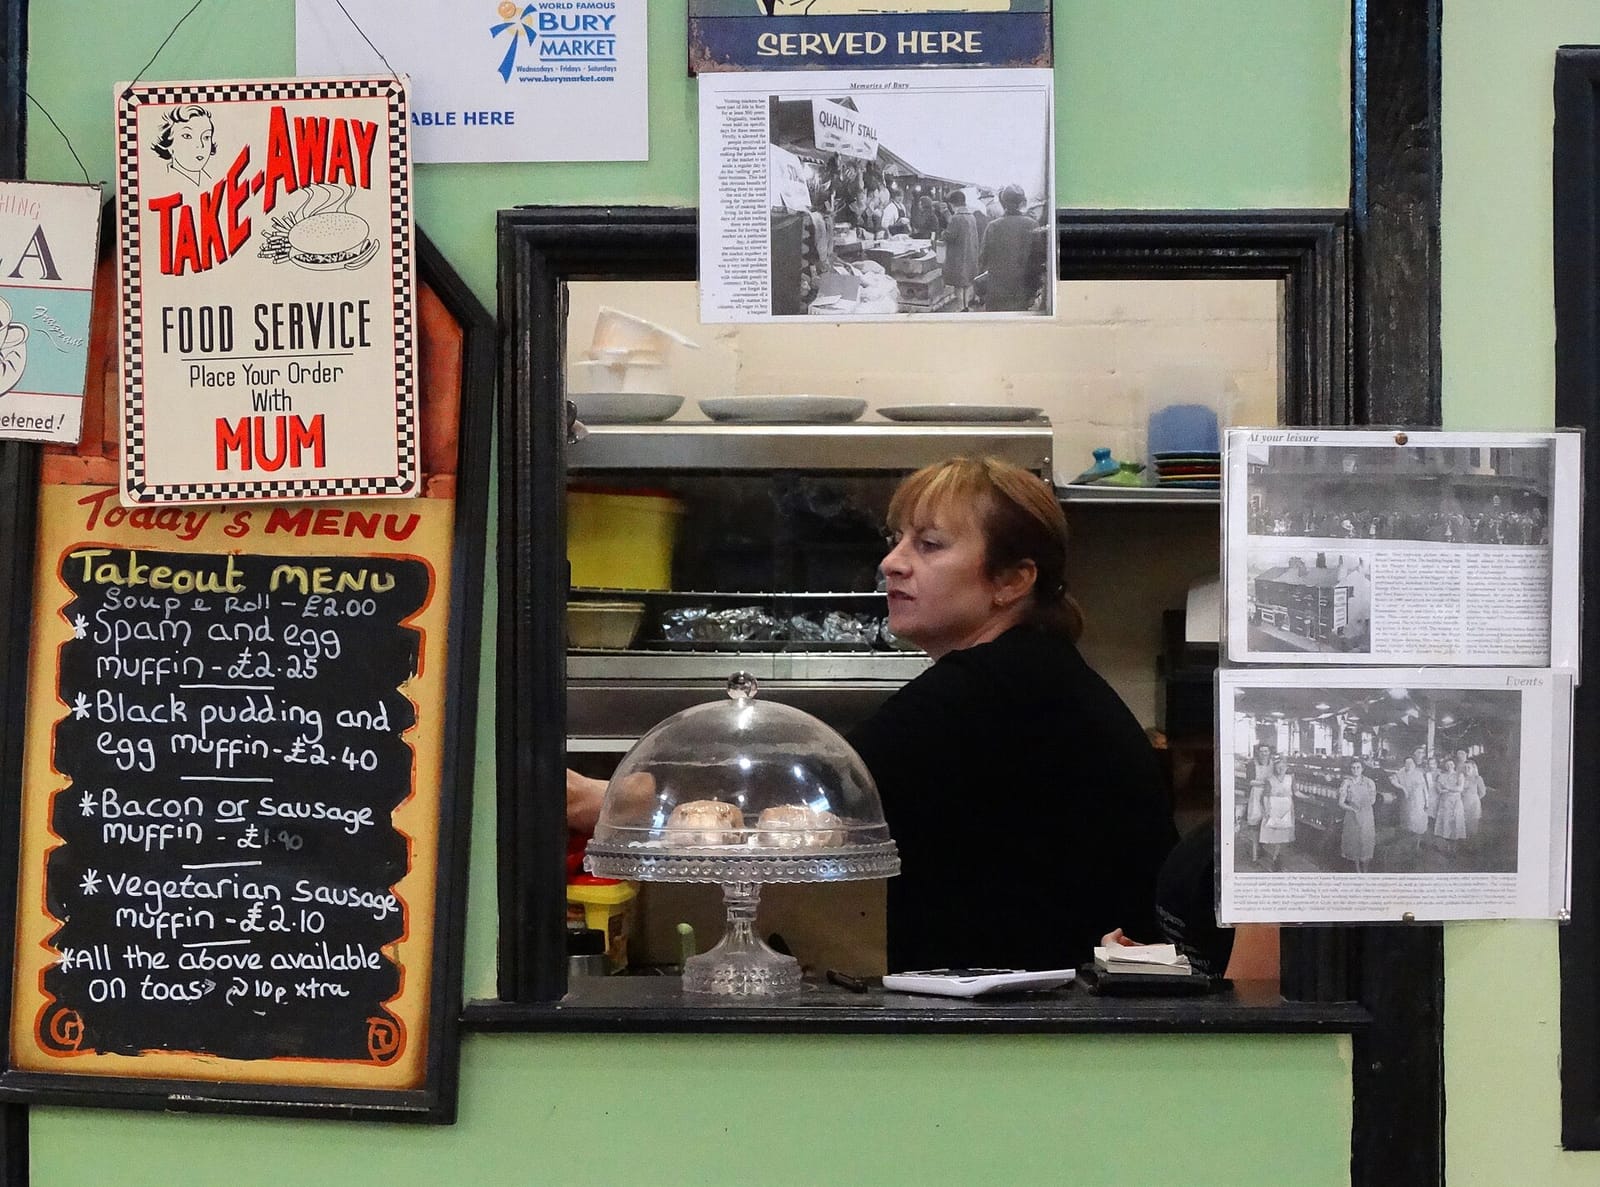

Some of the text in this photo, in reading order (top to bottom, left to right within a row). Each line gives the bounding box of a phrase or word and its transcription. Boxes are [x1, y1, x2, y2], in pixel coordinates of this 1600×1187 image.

[539, 2, 616, 10] WORLD FAMOUS
[539, 12, 616, 31] BURY
[540, 40, 617, 55] MARKET
[757, 30, 983, 57] SERVED HERE
[516, 65, 617, 73] Wednesdays Fridays Saturdays
[519, 75, 615, 84] www.burymarket.com
[849, 82, 882, 90] Memories
[884, 82, 891, 90] of
[463, 112, 515, 126] HERE
[819, 110, 879, 141] QUALITY STALL
[148, 106, 379, 276] TAKE-AWAY
[0, 223, 63, 281] A
[162, 300, 371, 354] FOOD SERVICE
[190, 360, 344, 388] Place Your Order
[251, 388, 292, 412] With
[215, 413, 326, 472] MUM
[1261, 434, 1285, 444] your
[1286, 432, 1320, 442] leisure
[78, 487, 421, 542] Today's MENU
[70, 549, 396, 595] Takeout MENU
[103, 587, 182, 618] Soup
[225, 592, 270, 614] Roll
[301, 594, 377, 618] £2.00
[93, 608, 342, 660] Spam and egg
[96, 650, 204, 686] muffin
[227, 646, 319, 680] £2.25
[1505, 675, 1544, 686] Events
[95, 689, 391, 745] Black pudding and
[96, 730, 156, 771] egg
[171, 732, 269, 769] muffin
[283, 739, 379, 771] £2.40
[100, 788, 204, 819] Bacon
[215, 798, 246, 823] or
[102, 818, 204, 852] muffin
[116, 908, 215, 939] muffin
[239, 902, 326, 934] £2.10
[75, 943, 382, 972] All the above available
[140, 974, 217, 1001] toas
[294, 977, 351, 999] xtra
